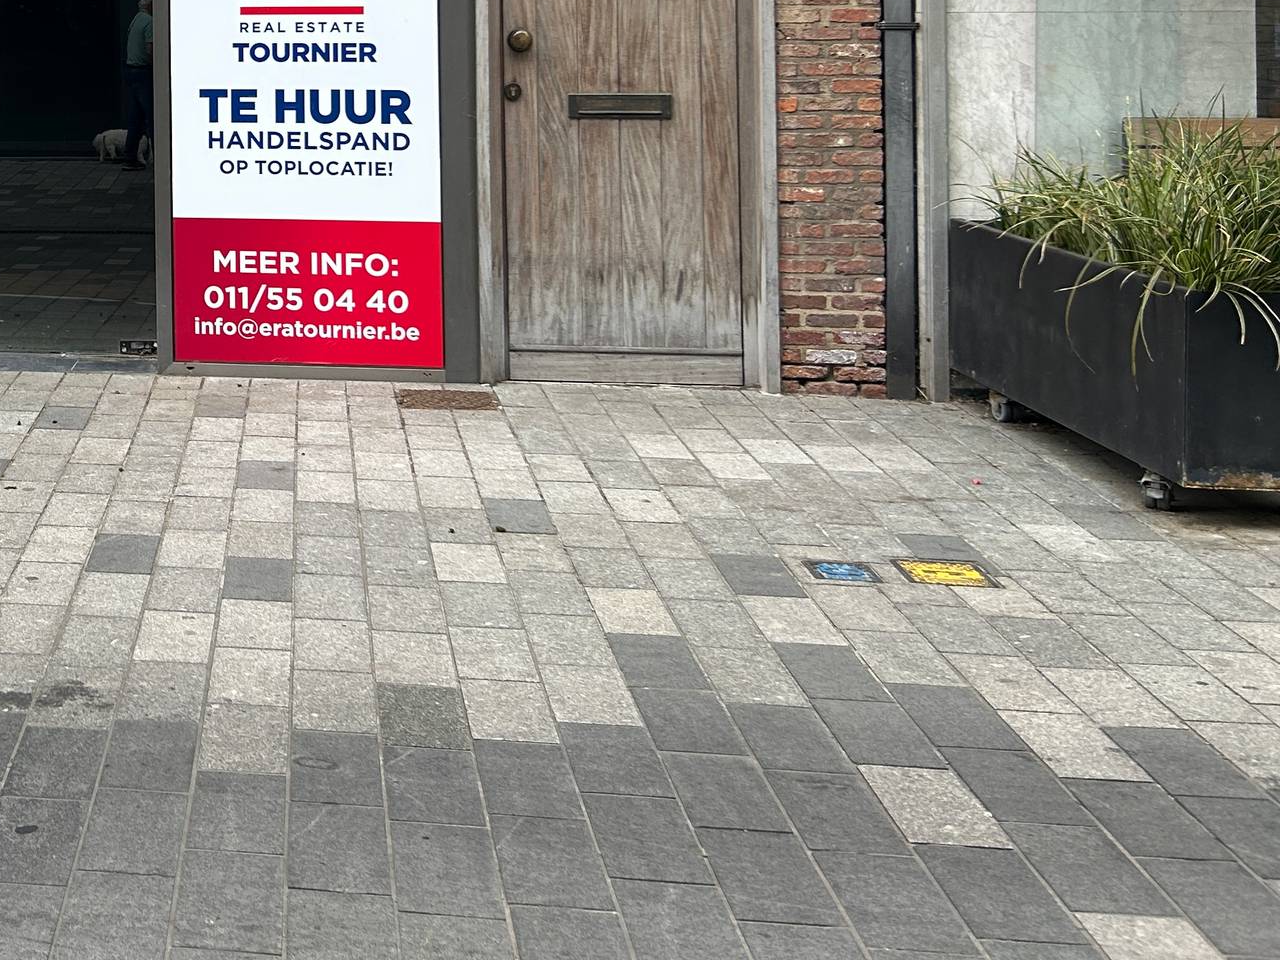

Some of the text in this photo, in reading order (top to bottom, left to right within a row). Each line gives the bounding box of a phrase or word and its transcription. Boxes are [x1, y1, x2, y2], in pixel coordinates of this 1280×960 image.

[239, 21, 366, 34] REAL ESTATE
[232, 42, 378, 63] TOURNIER
[199, 89, 413, 125] TE HUUR
[208, 130, 411, 152] HANDELSPAND
[219, 159, 394, 177] OP TOPLOCATIE!
[213, 250, 400, 278] MEER INFO:
[203, 283, 410, 315] 011/55 04 40
[193, 316, 421, 342] info@eratournier.be
